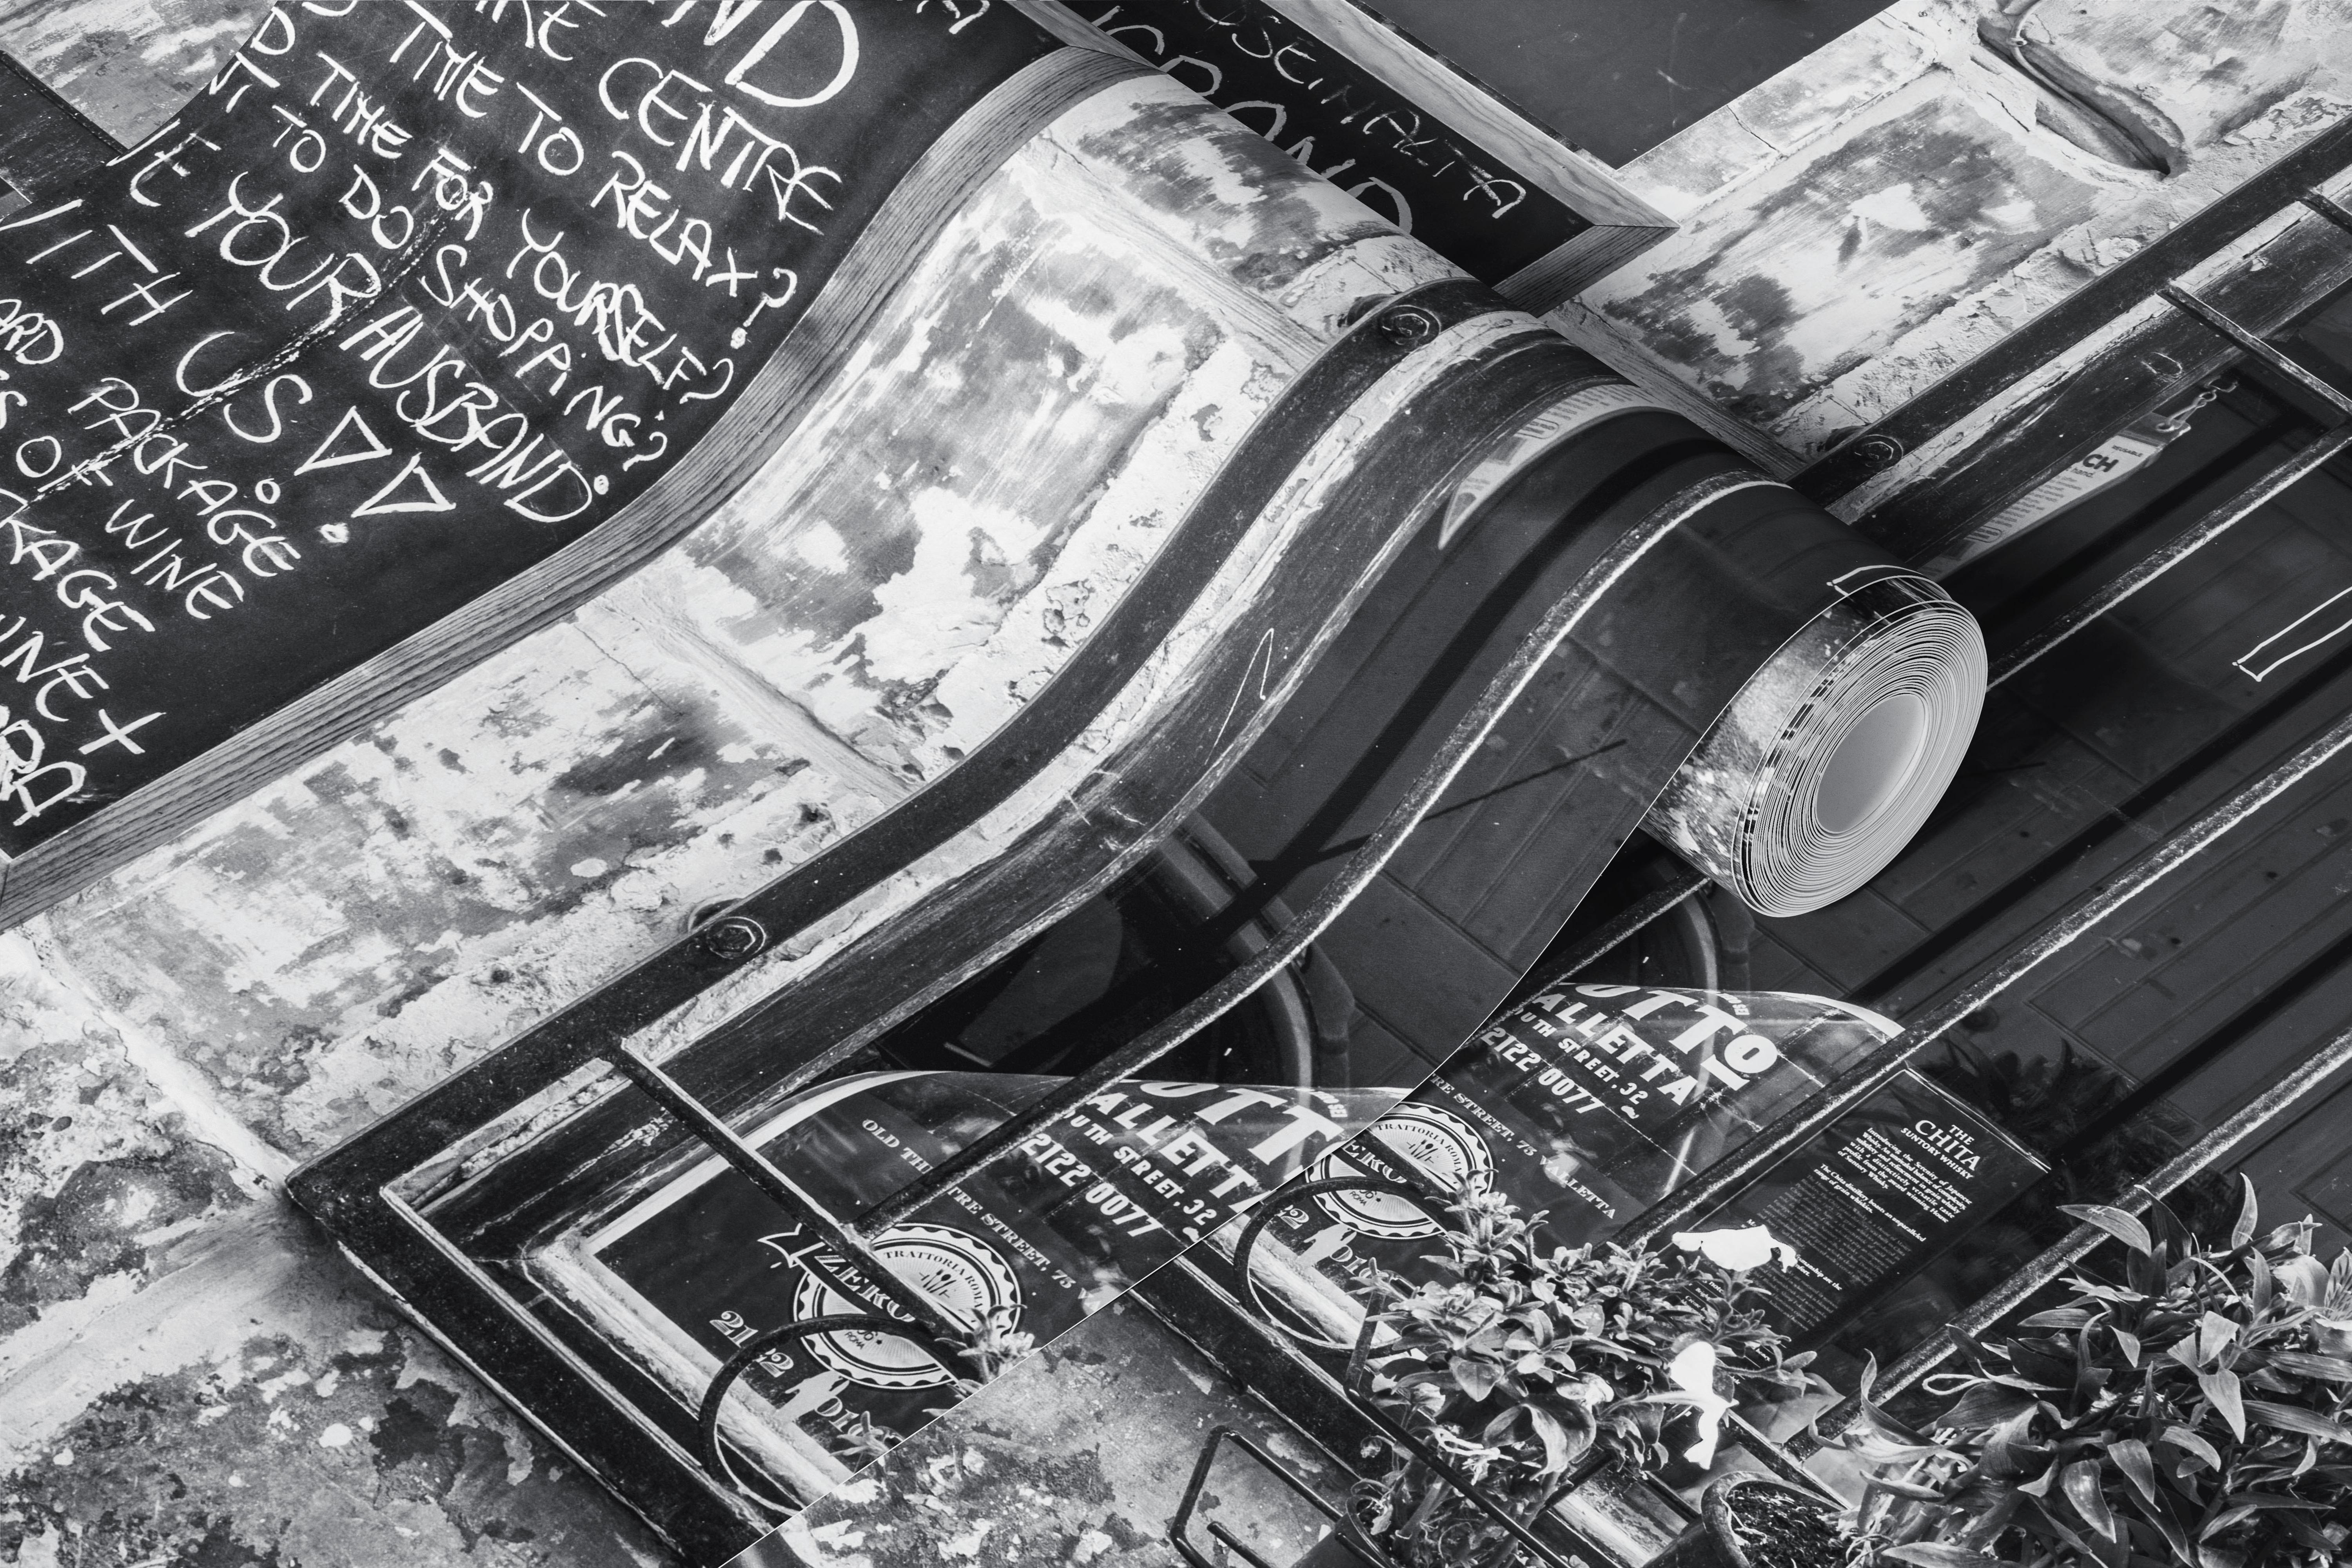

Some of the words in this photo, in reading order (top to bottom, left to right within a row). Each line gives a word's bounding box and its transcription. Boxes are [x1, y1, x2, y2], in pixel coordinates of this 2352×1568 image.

[272, 104, 326, 172] TO
[339, 164, 414, 249] DO
[310, 50, 413, 159] TIME
[412, 147, 494, 241] FOR
[389, 0, 505, 118] TIME
[516, 82, 584, 176] TO
[590, 151, 798, 349] RELAX?
[598, 57, 842, 235] CENTRE
[183, 172, 381, 331] YOUR
[67, 377, 301, 577] PACKAGE
[105, 499, 244, 619] WINE
[1480, 1024, 1543, 1073] 2122
[1536, 1065, 1605, 1114] 0077
[1532, 996, 1699, 1106] ALLETTA
[1020, 1132, 1093, 1188] 2122
[1083, 1180, 1163, 1237] 0077
[1085, 1096, 1272, 1214] ALLETT
[1454, 1093, 1514, 1141] STREET,
[1517, 1140, 1537, 1156] 75
[1539, 1155, 1617, 1220] VALLETTA
[1867, 1128, 1902, 1154] Introducing
[1915, 1162, 1938, 1180] Serenity
[1901, 1128, 1941, 1156] SUNTORY
[1940, 1155, 1973, 1179] WHISKY
[1916, 1120, 1980, 1171] CHITA
[1949, 1125, 1974, 1145] THE
[863, 1120, 900, 1147] OLD
[901, 1147, 983, 1214] THTRE
[981, 1214, 1051, 1271] STREET,
[1052, 1270, 1076, 1288] 75
[886, 1251, 965, 1275] TRATTORIA
